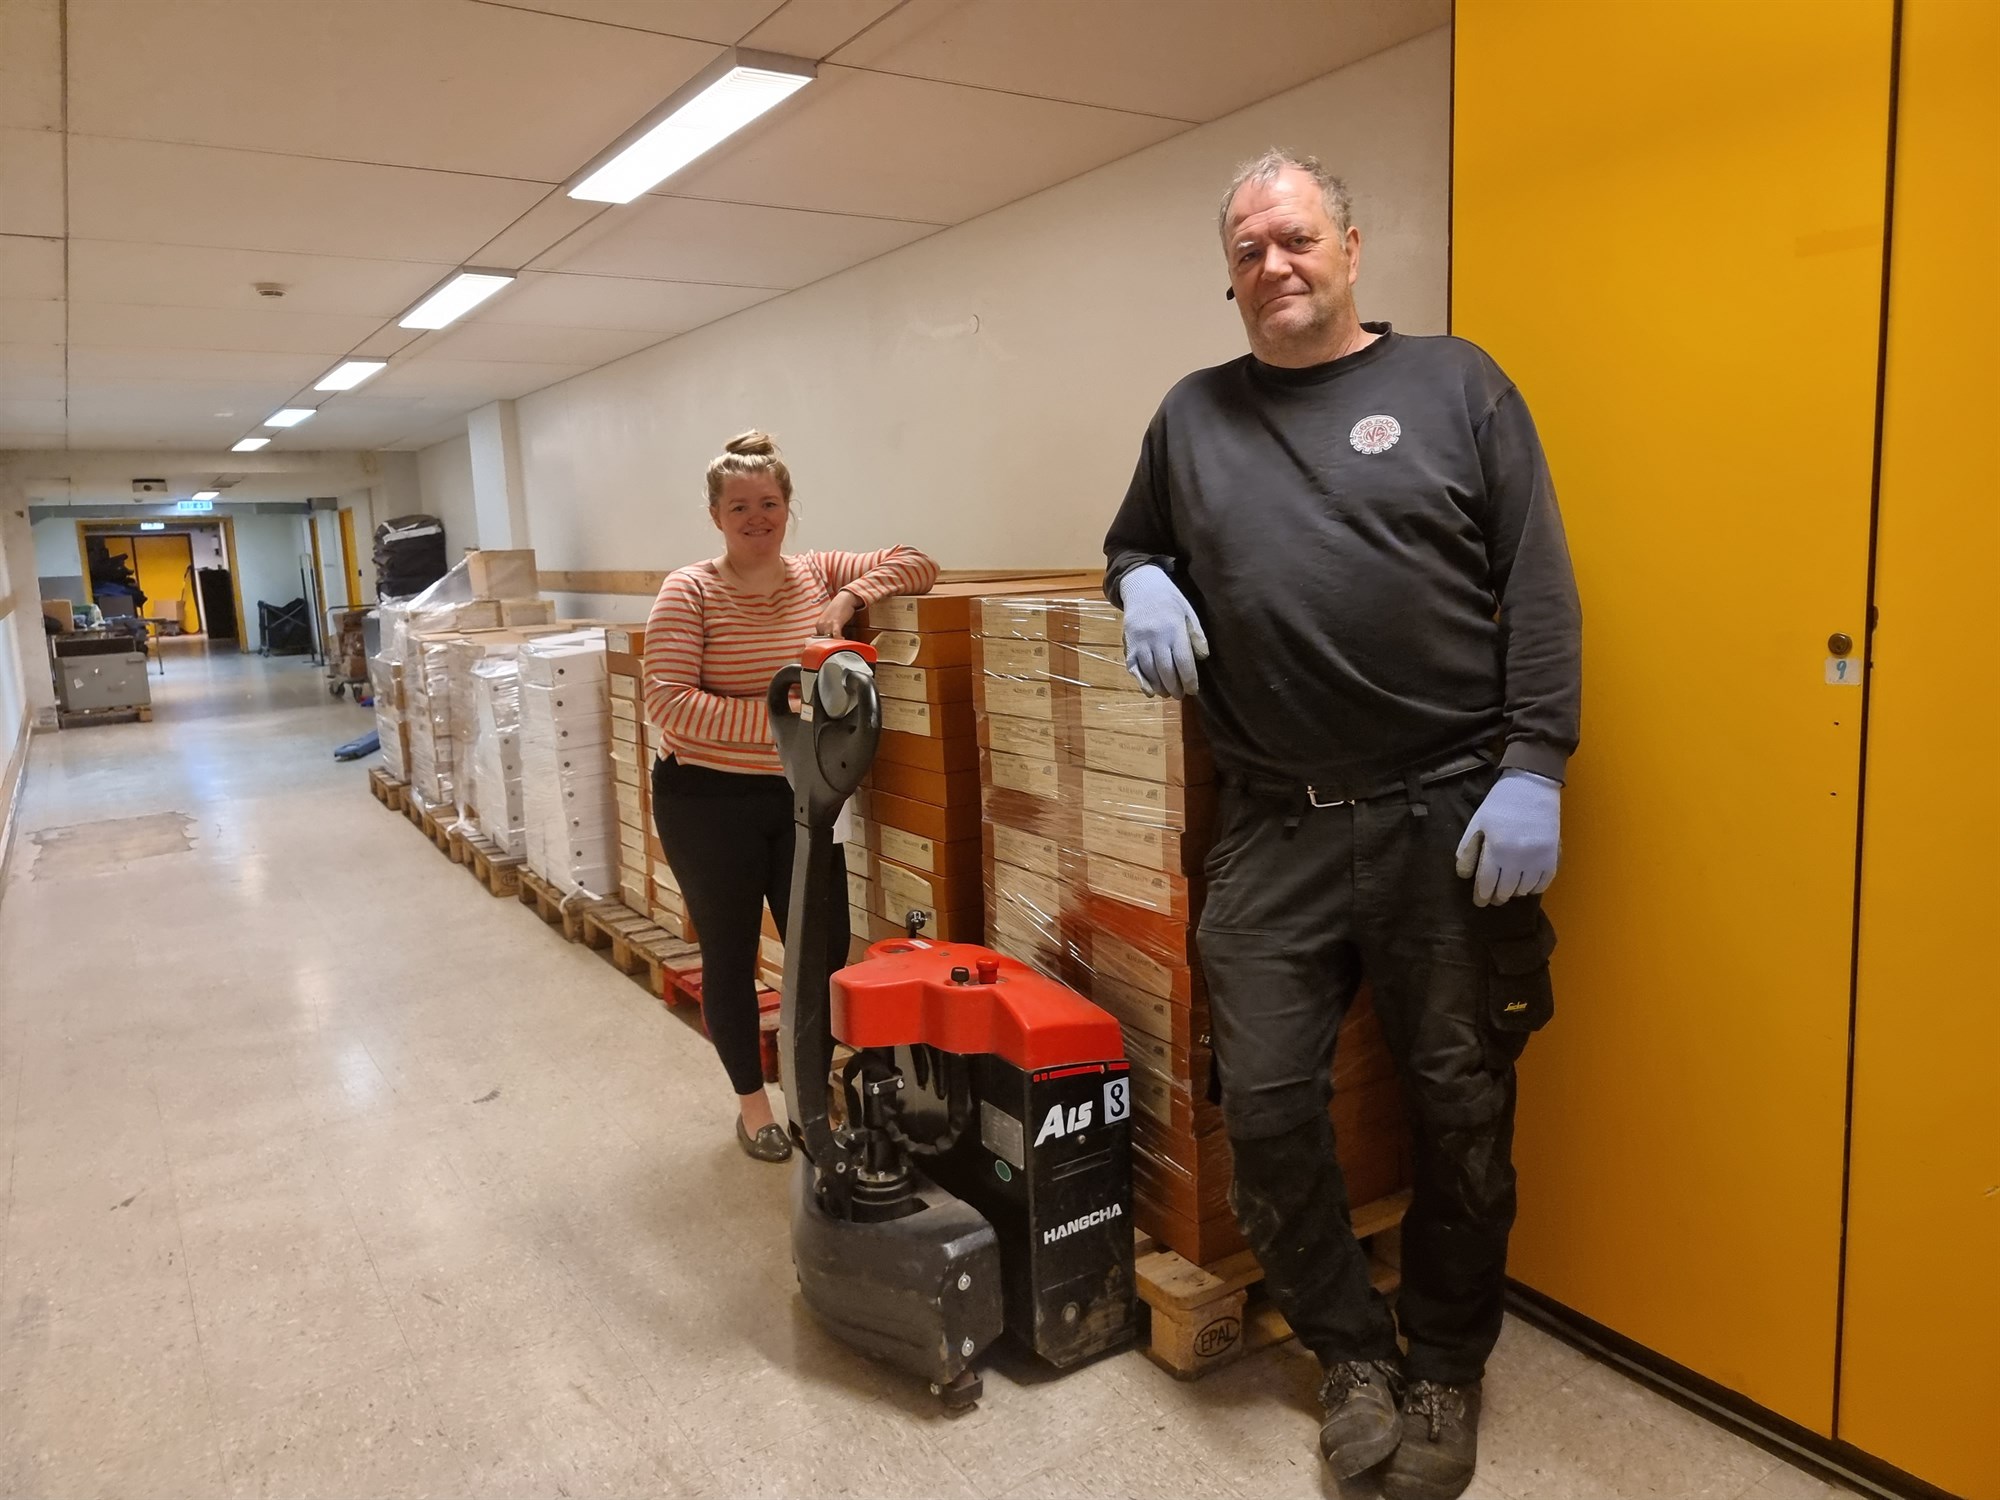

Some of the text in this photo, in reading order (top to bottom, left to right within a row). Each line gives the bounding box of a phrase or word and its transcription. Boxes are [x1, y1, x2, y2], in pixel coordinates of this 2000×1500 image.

[1836, 660, 1847, 680] 9
[1043, 1203, 1122, 1245] HANGCHA
[1201, 1323, 1234, 1353] EPAL
